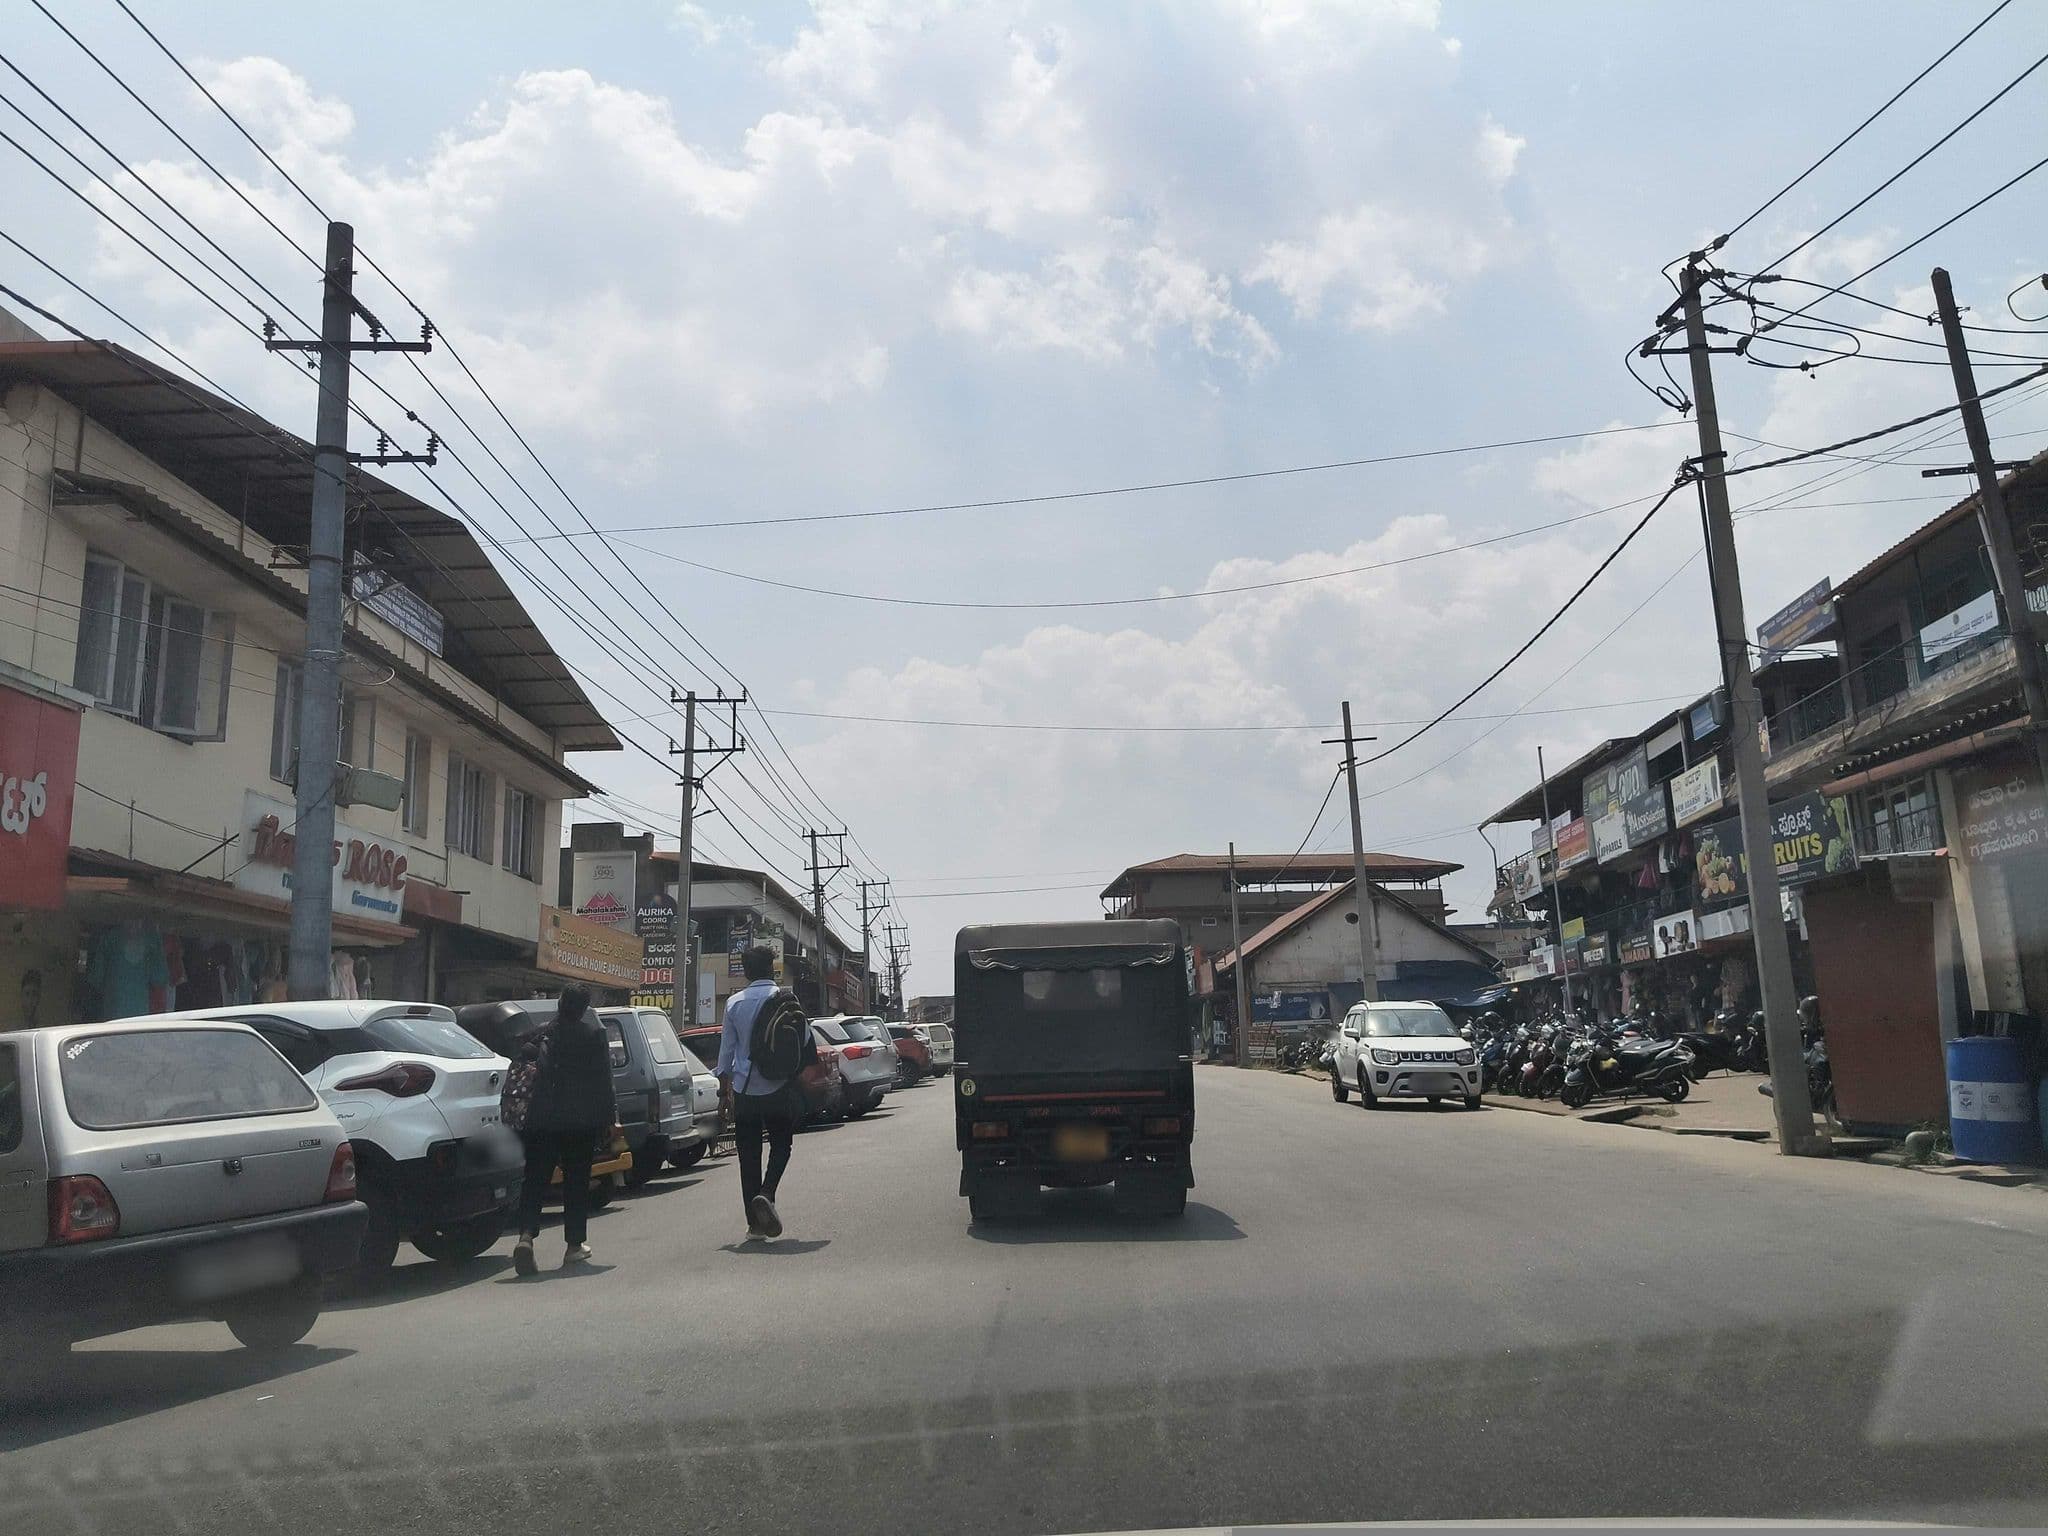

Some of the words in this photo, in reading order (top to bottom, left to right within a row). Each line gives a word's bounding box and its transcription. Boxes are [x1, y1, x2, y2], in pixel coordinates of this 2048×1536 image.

[1774, 832, 1823, 865] RUITS
[576, 904, 628, 914] Mahalakshmi
[637, 907, 674, 917] AURIKA
[557, 949, 588, 969] POPULAR
[590, 957, 607, 974] HOME
